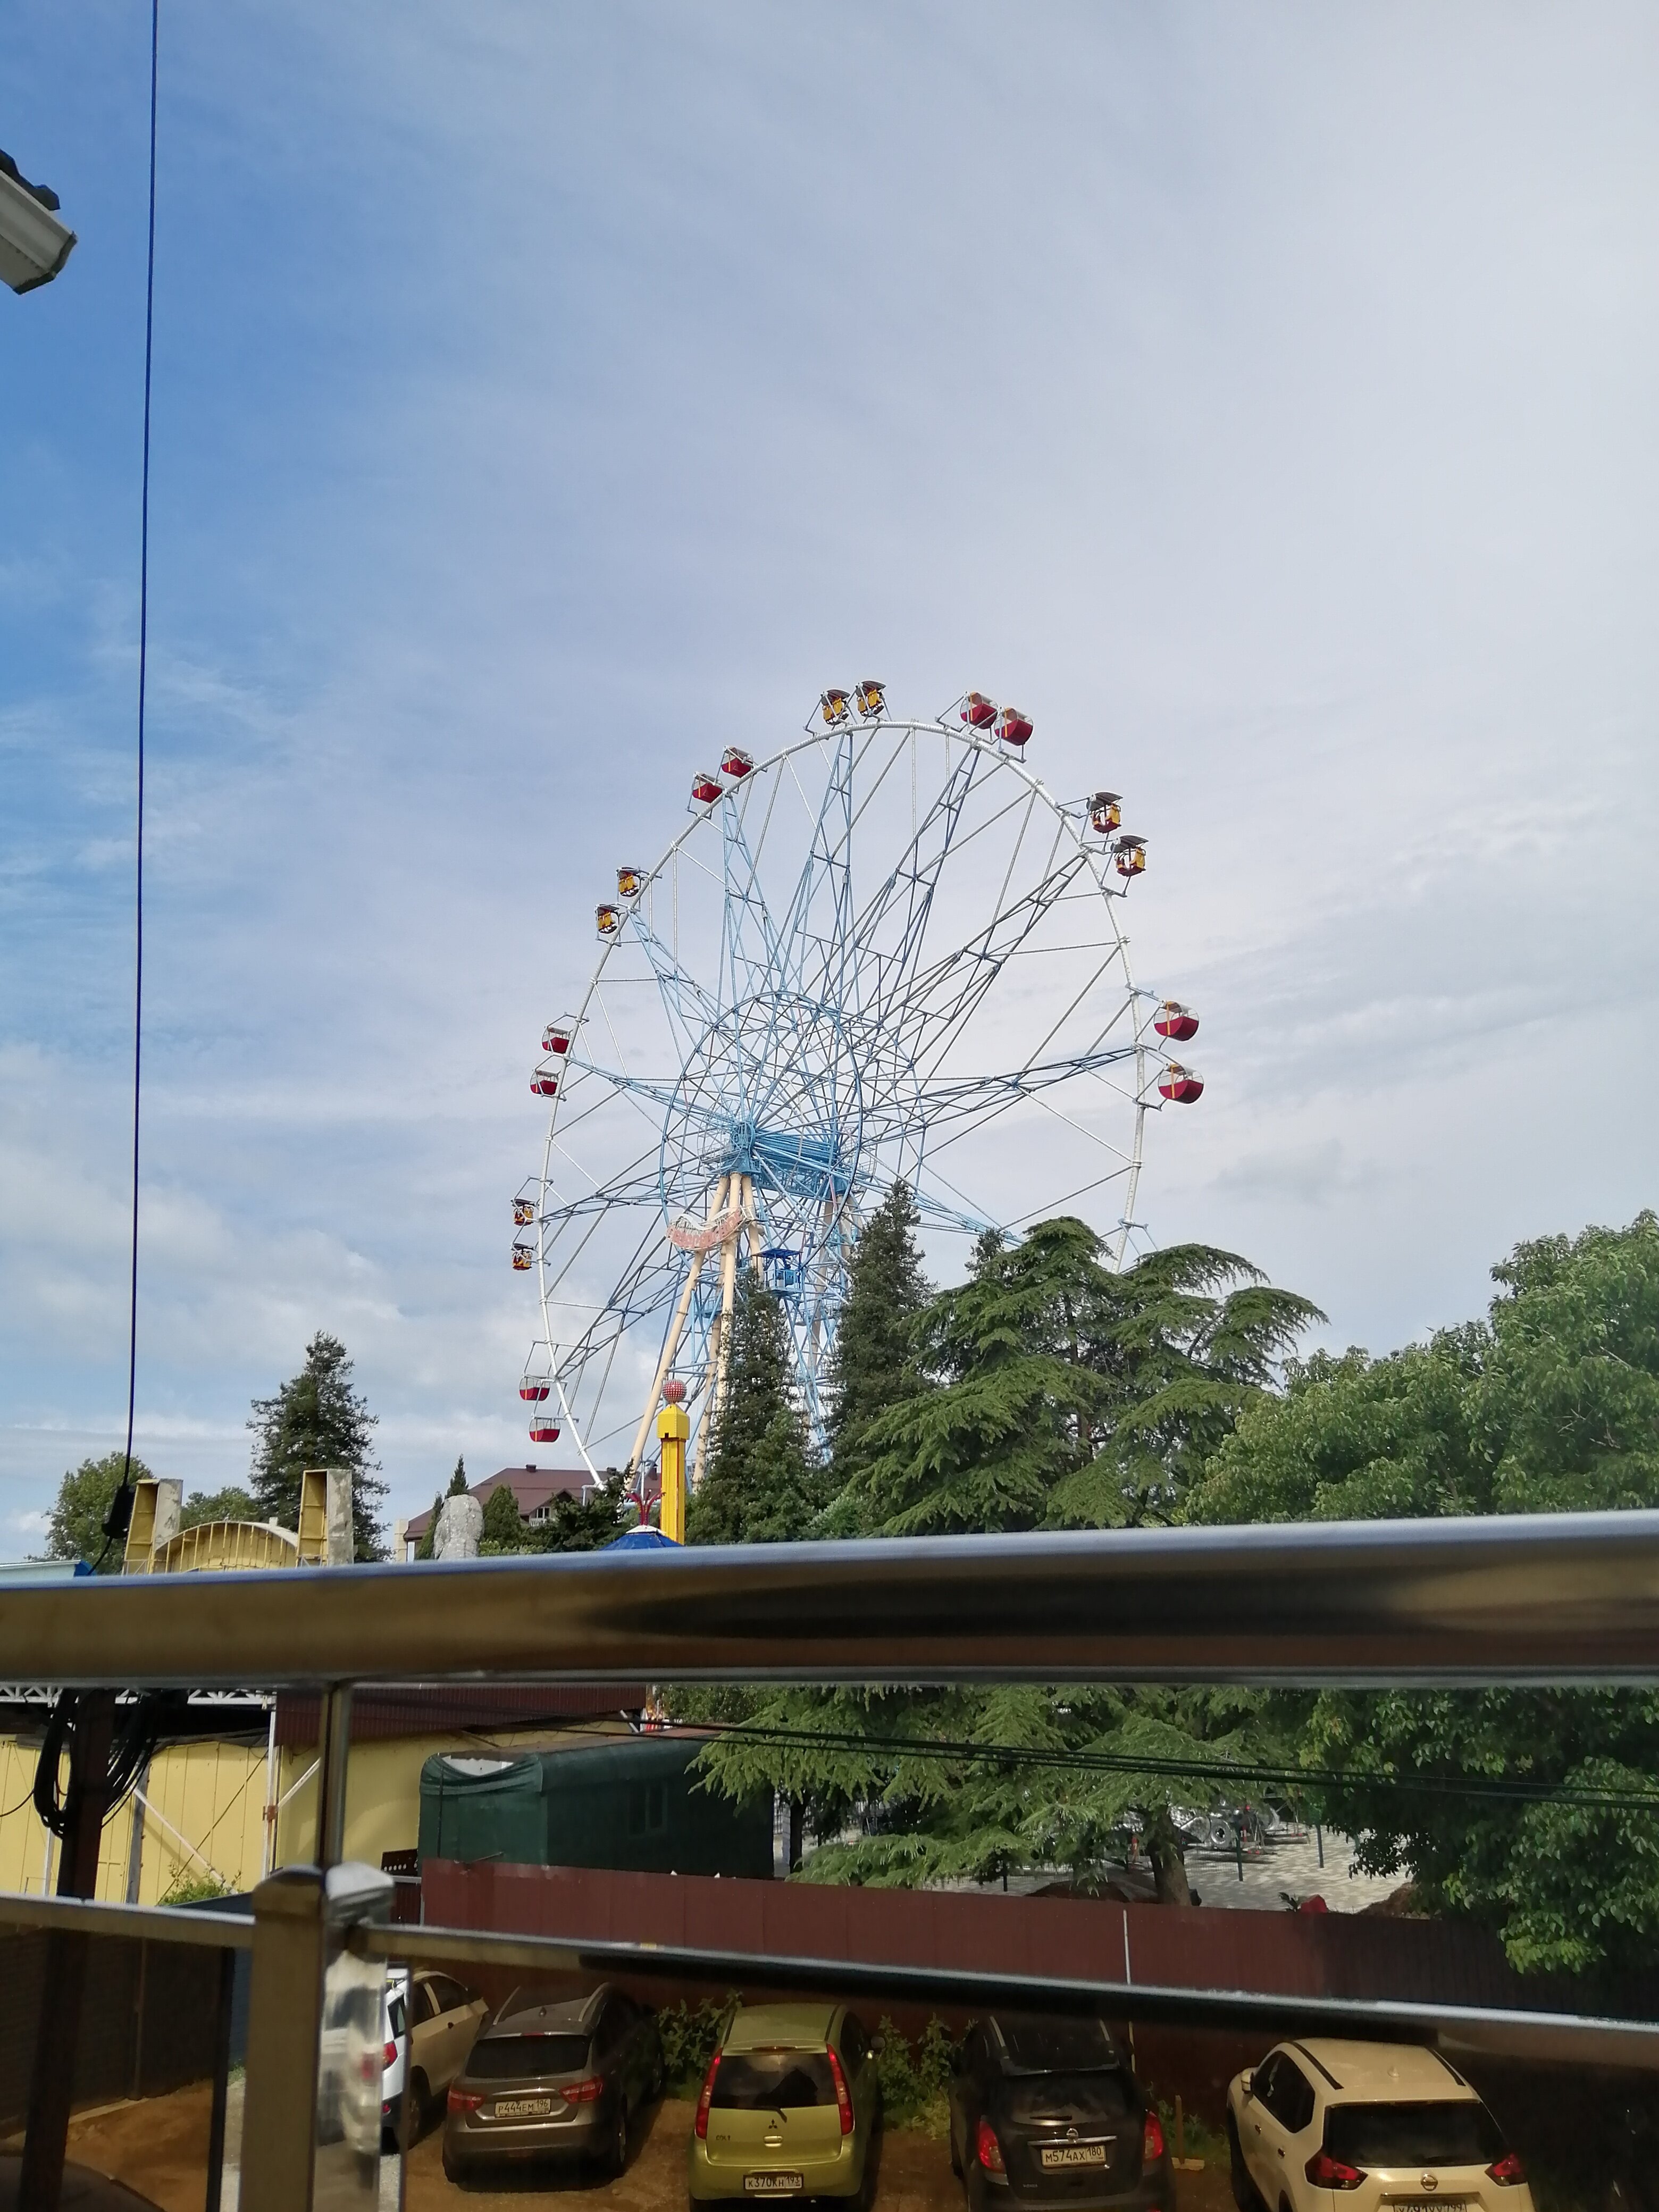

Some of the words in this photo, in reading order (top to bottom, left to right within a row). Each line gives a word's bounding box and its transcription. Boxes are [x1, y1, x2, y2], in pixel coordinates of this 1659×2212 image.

[498, 2102, 534, 2114] Р444ЕМ
[1045, 2149, 1085, 2163] М574АХ
[1087, 2147, 1101, 2156] 180
[748, 2177, 784, 2188] К370КН
